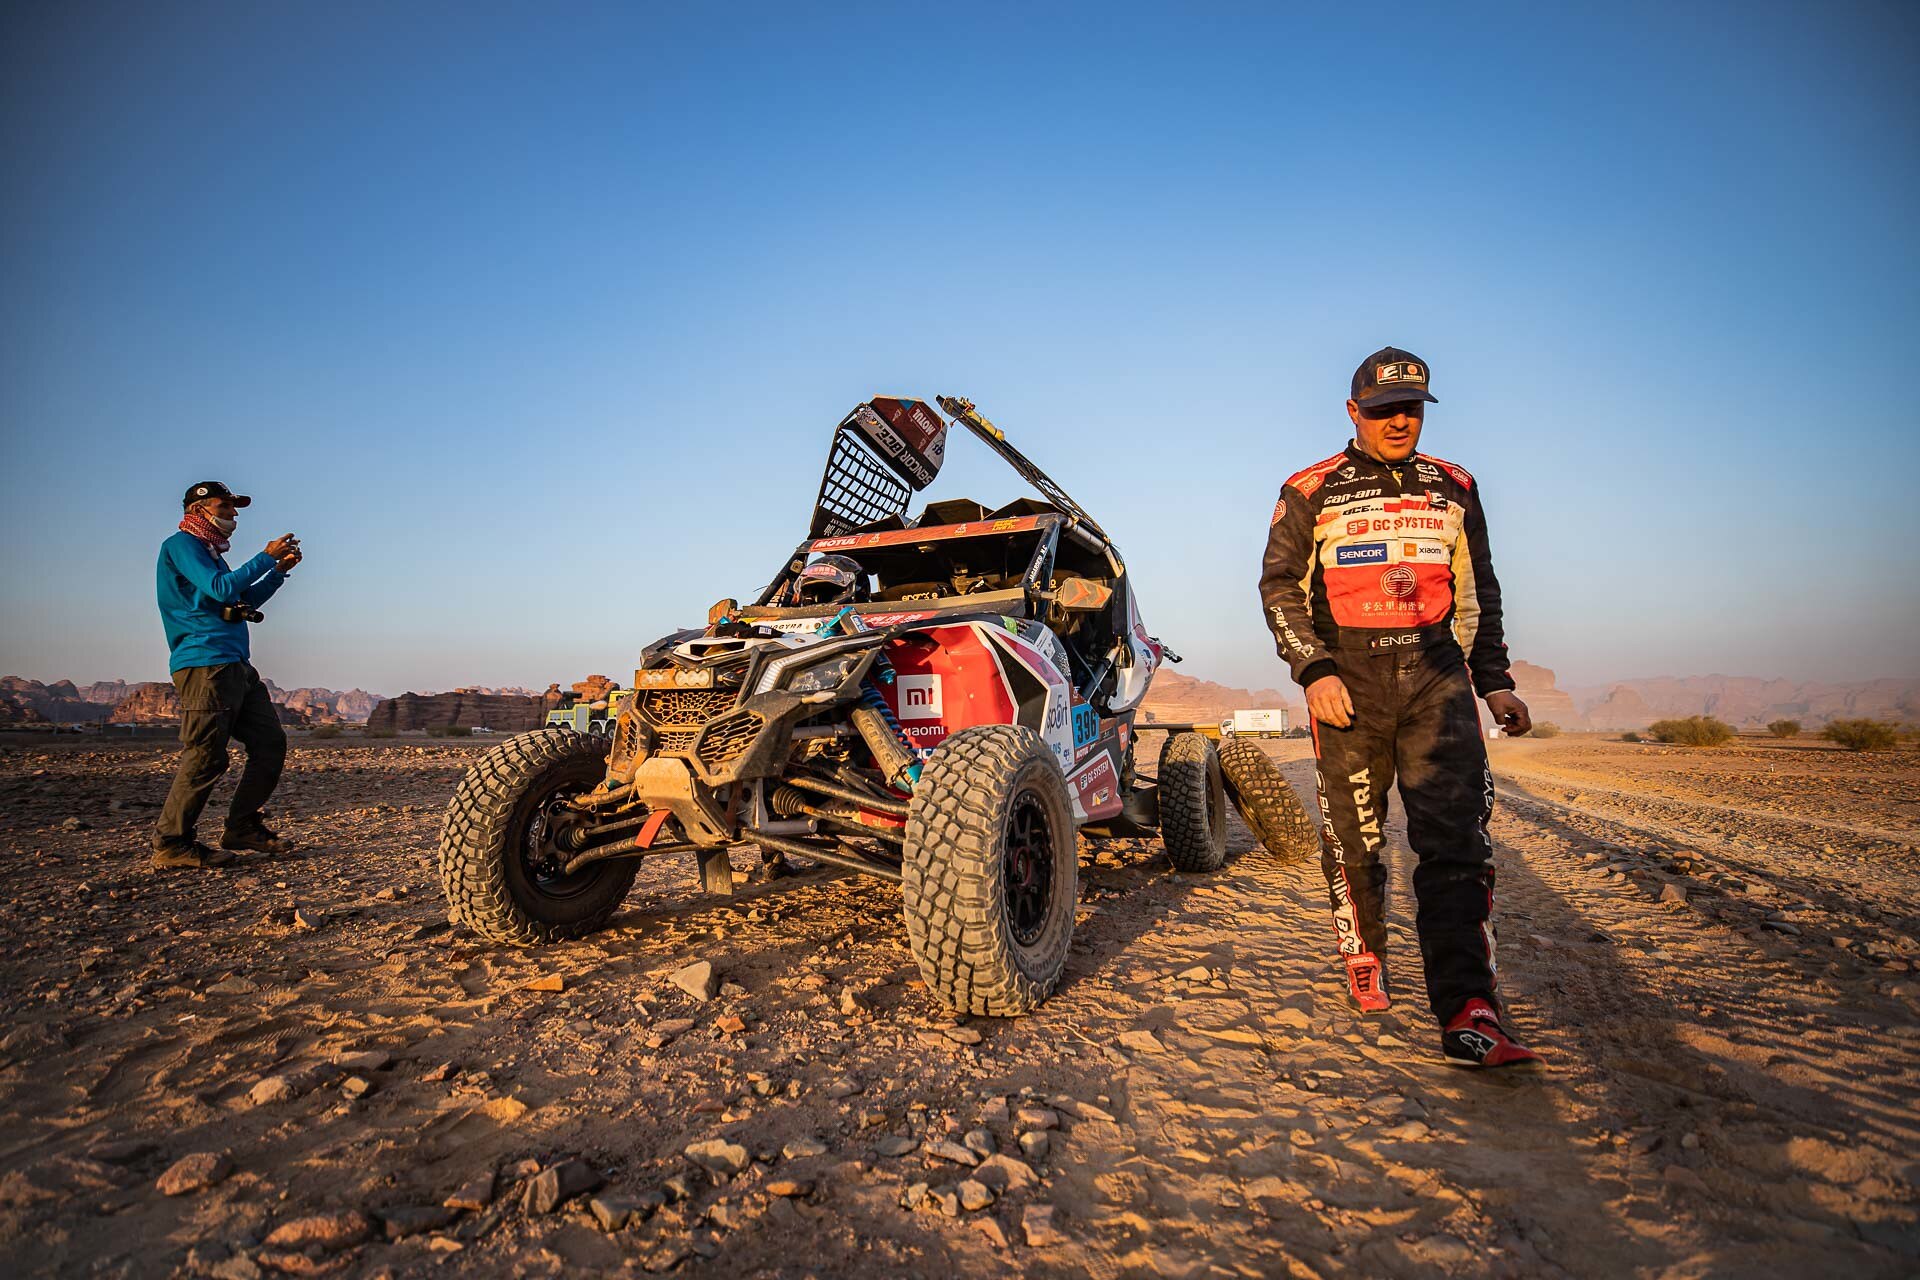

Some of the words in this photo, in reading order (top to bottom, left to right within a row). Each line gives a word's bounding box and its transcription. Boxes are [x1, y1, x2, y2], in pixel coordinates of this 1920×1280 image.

[912, 408, 936, 436] MOTUL
[901, 450, 933, 485] SENCOR
[1373, 520, 1391, 531] GC
[1394, 517, 1443, 531] SYSTEM
[815, 538, 857, 548] MOTUL
[1339, 549, 1384, 560] SENCOR
[1379, 634, 1421, 647] ENGE
[1076, 710, 1097, 743] 396
[1348, 767, 1380, 851] TATRA
